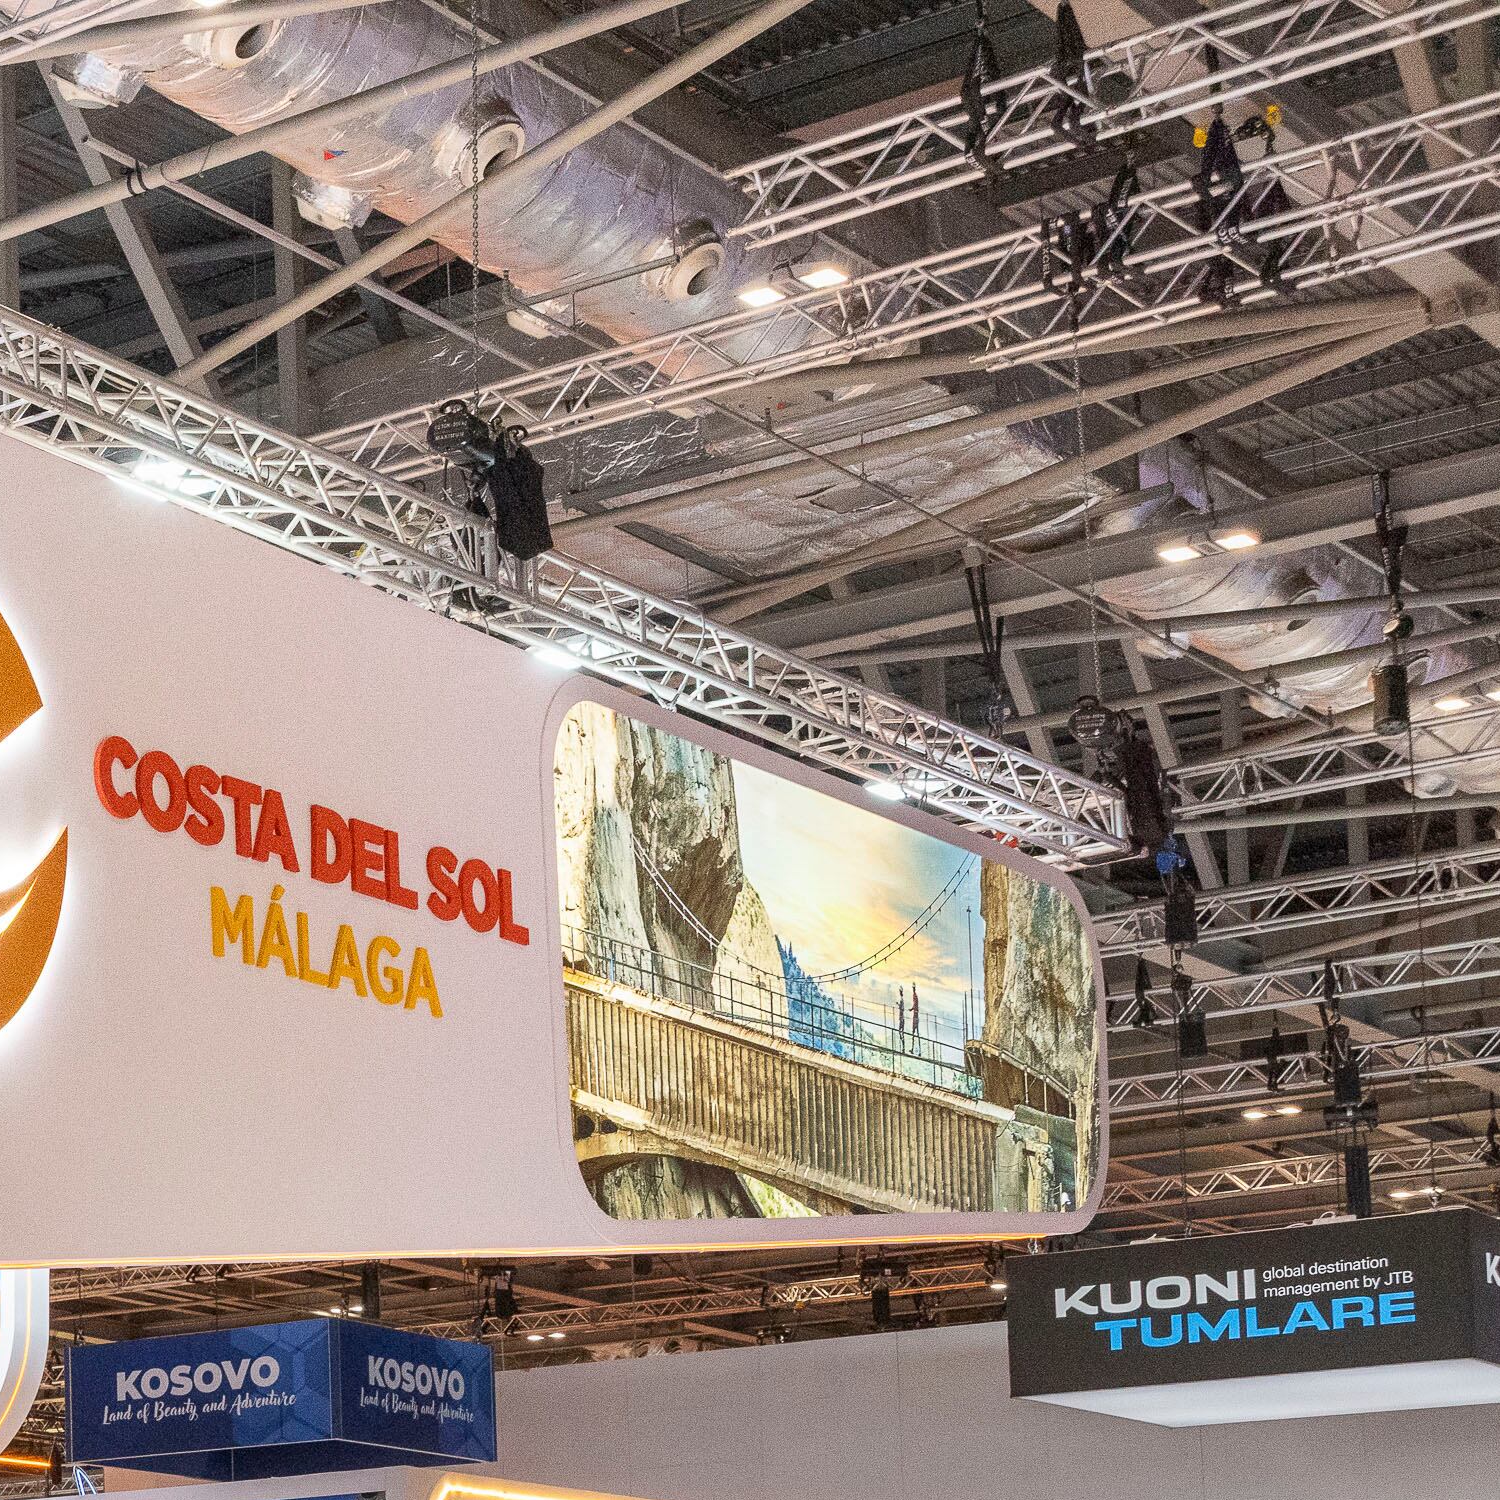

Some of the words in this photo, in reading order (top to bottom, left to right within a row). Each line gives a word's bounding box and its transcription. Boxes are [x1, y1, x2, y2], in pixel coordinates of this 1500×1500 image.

[94, 735, 300, 873] COSTA
[310, 803, 419, 910] DEL
[426, 846, 530, 946] SOL
[210, 884, 444, 1018] MÁLAGA
[1262, 1263, 1306, 1283] global
[1308, 1256, 1389, 1276] destination
[1263, 1278, 1360, 1300] management
[1362, 1273, 1381, 1292] by
[1383, 1270, 1414, 1286] JTB
[1054, 1268, 1257, 1319] KUONI
[1094, 1291, 1417, 1352] TUMLARE
[116, 1355, 281, 1401] KOSOVO
[368, 1355, 465, 1401] KOSOVO
[103, 1403, 132, 1425] Land
[137, 1401, 150, 1424] of
[154, 1400, 199, 1422] Beauty
[202, 1395, 227, 1413] and
[230, 1390, 296, 1416] Adventure
[360, 1387, 379, 1409] Land
[380, 1392, 390, 1412] of
[391, 1394, 419, 1419] Beauty
[420, 1399, 435, 1415] and
[436, 1401, 475, 1423] Adventure
